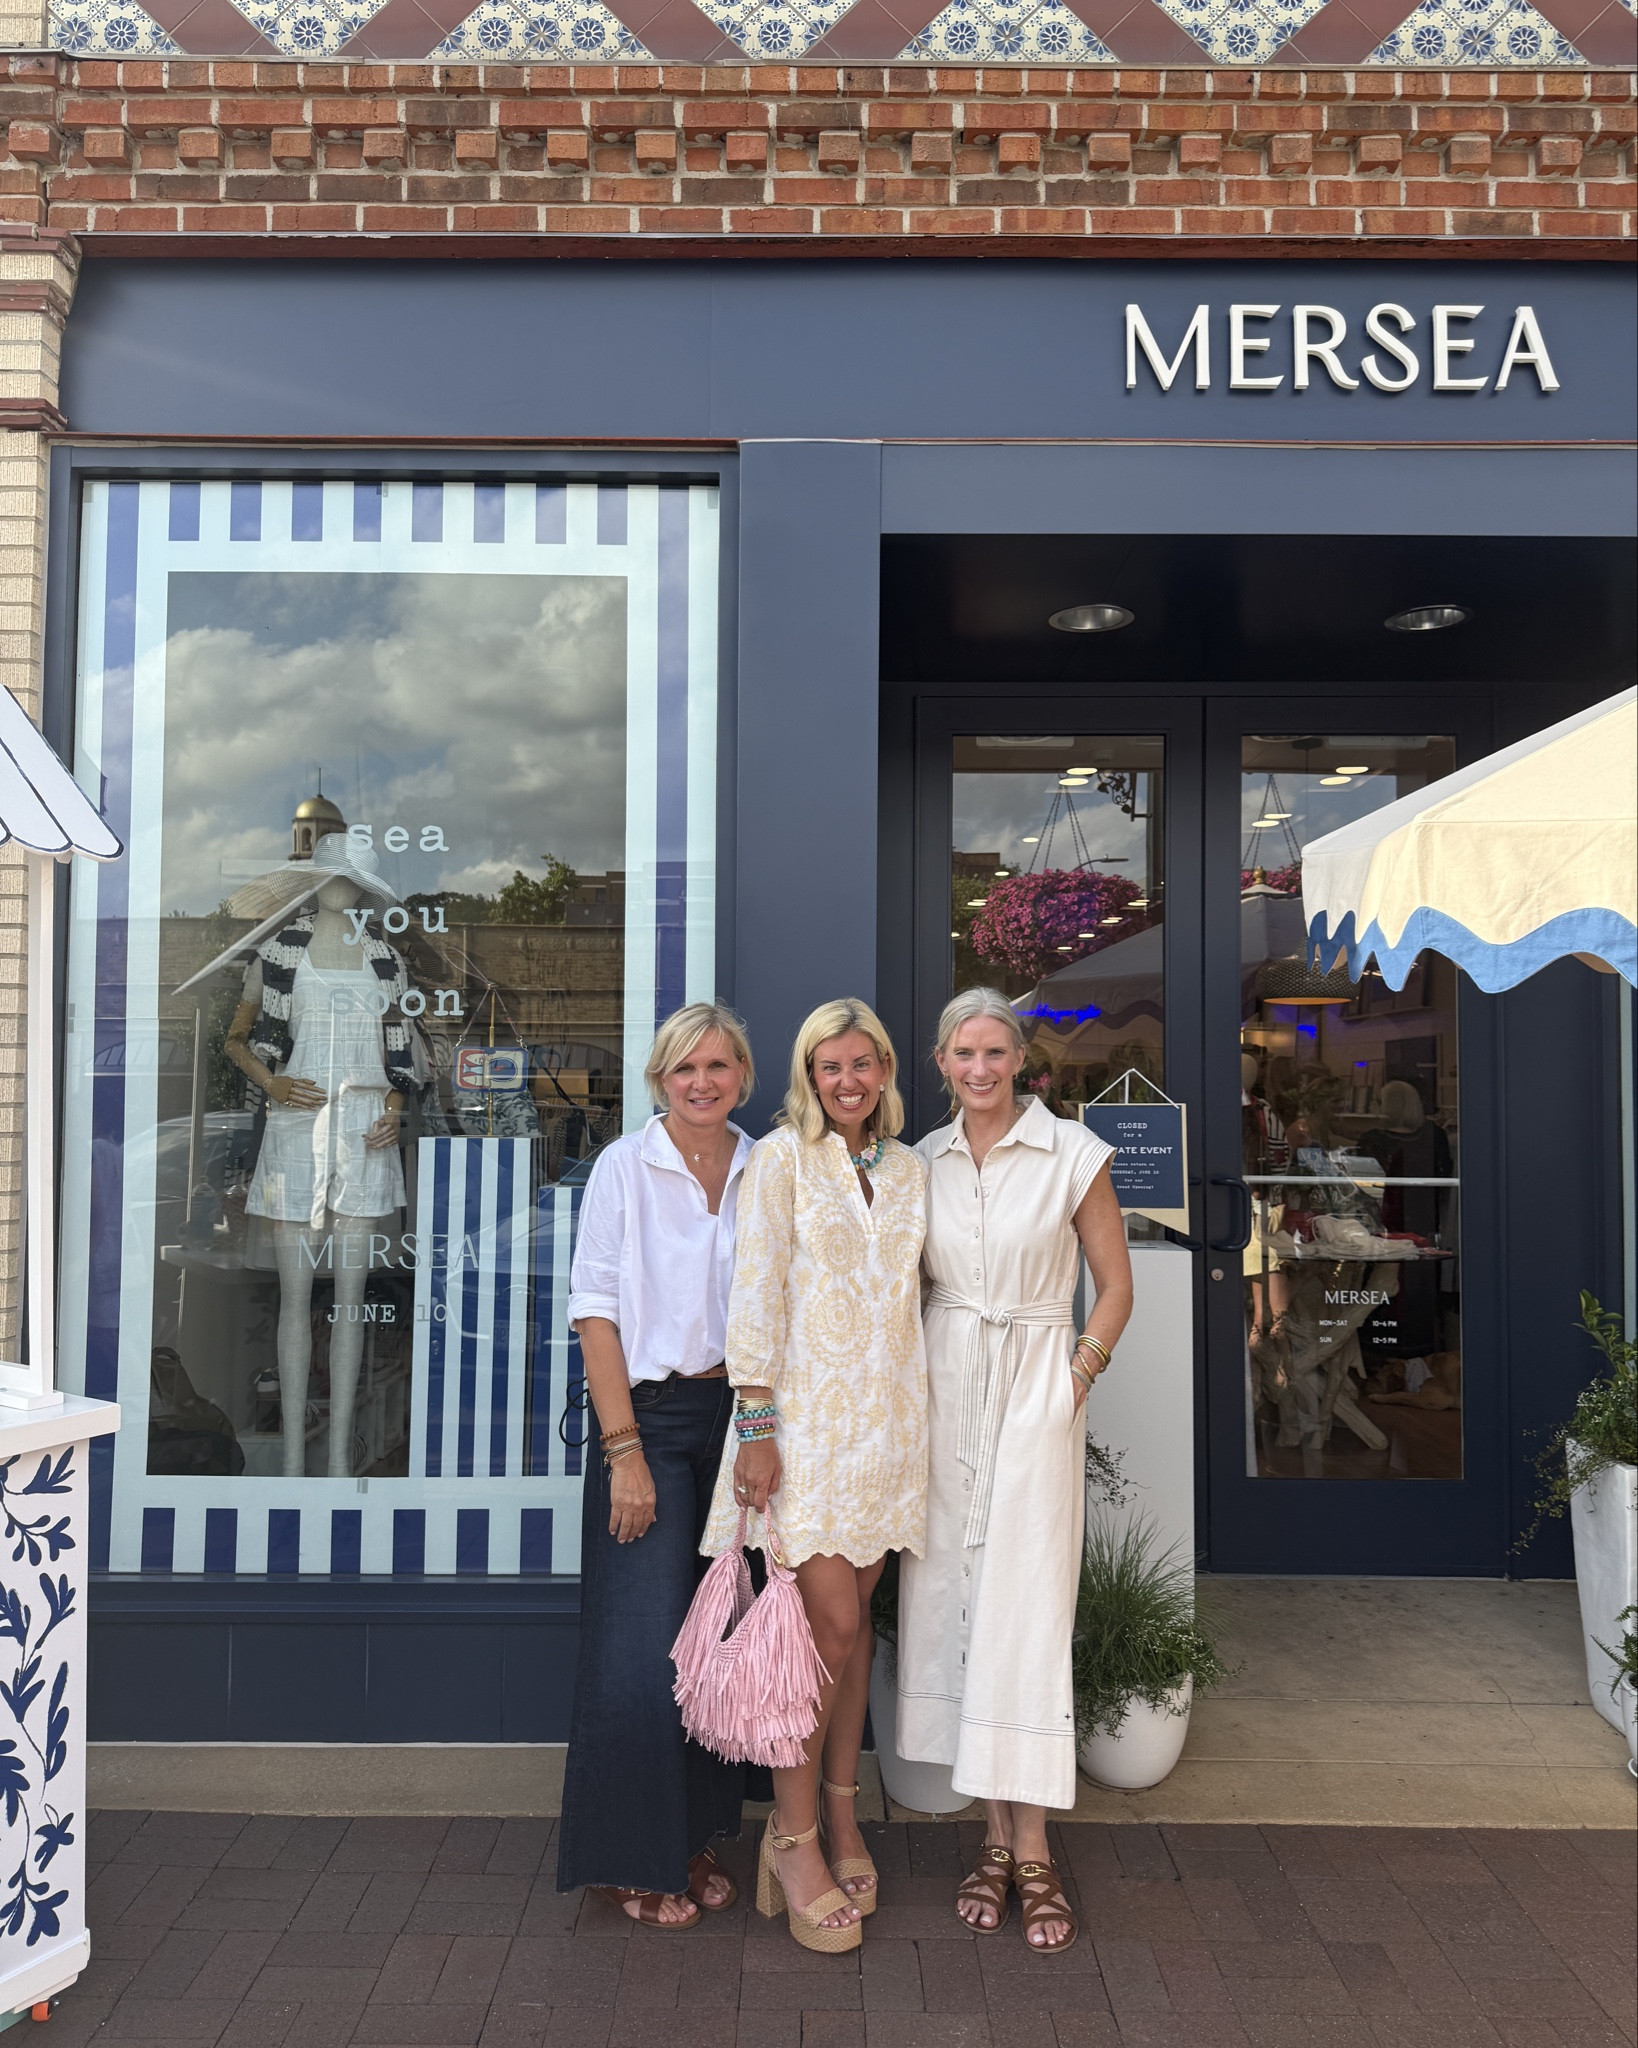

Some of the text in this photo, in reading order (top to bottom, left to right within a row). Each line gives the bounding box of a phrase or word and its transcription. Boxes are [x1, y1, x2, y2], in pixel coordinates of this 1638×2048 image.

[1125, 303, 1560, 392] MERSEA
[348, 823, 450, 852] sea
[342, 906, 449, 945] you
[328, 988, 464, 1017] soon
[1140, 1146, 1173, 1154] EVENT
[298, 1233, 479, 1270] MERSEA
[1324, 1290, 1390, 1305] MERSEA
[327, 1304, 447, 1323] JUNE 10
